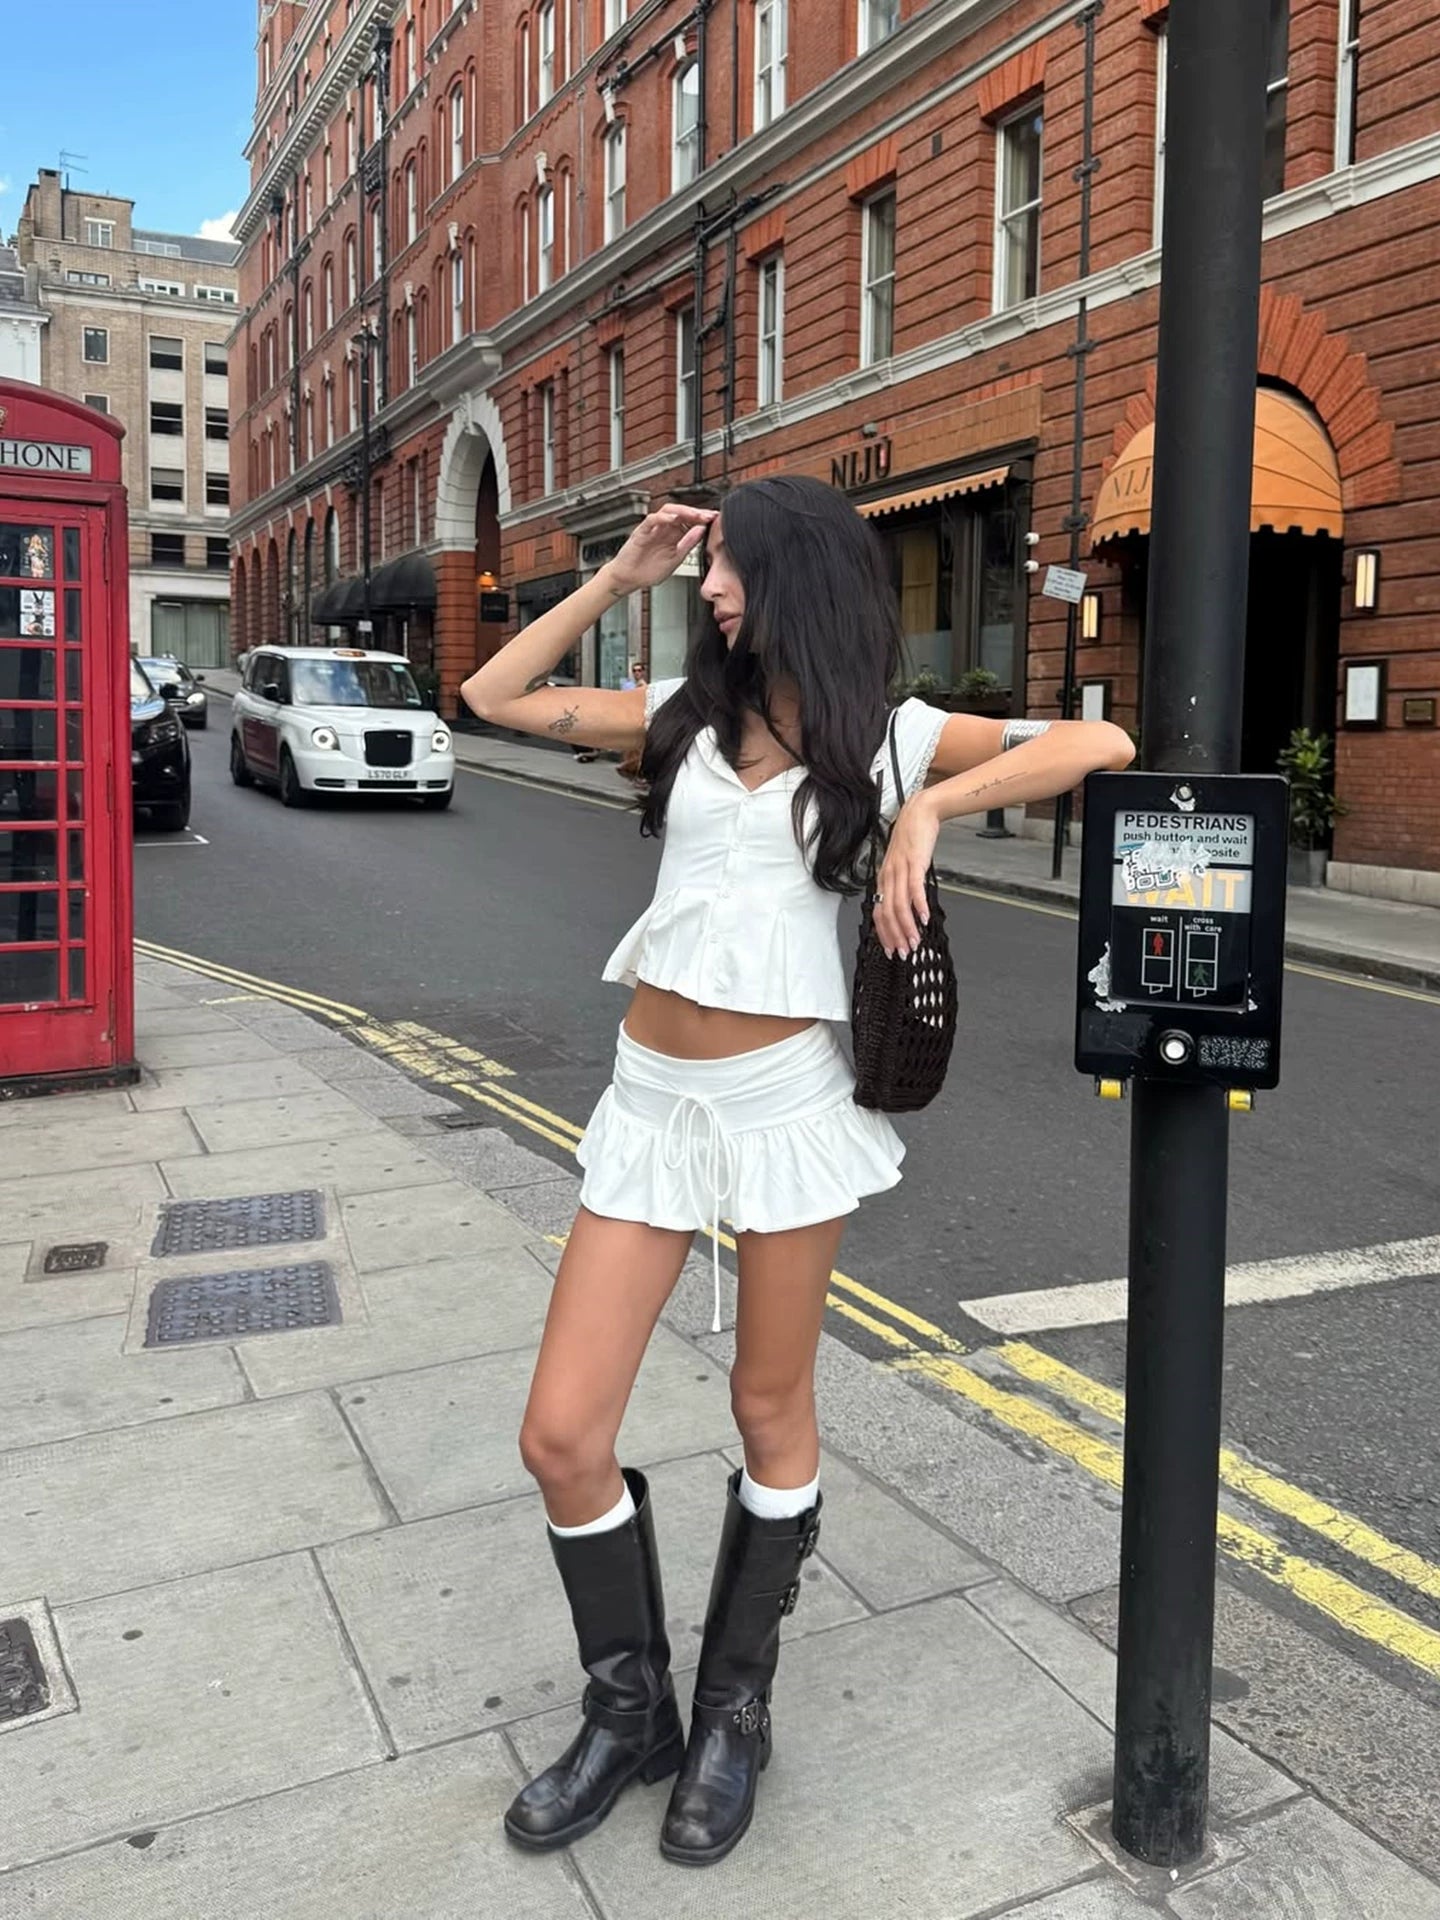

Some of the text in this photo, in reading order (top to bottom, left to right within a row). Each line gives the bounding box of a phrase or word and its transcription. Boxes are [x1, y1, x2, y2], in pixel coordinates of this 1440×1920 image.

[0, 442, 82, 471] HONE
[1124, 814, 1247, 831] PEDESTRIANS
[1123, 831, 1247, 845] push button and wait
[1128, 868, 1245, 910] AIT
[1150, 915, 1168, 924] wait
[1193, 916, 1214, 925] cross
[1184, 924, 1223, 934] with care
